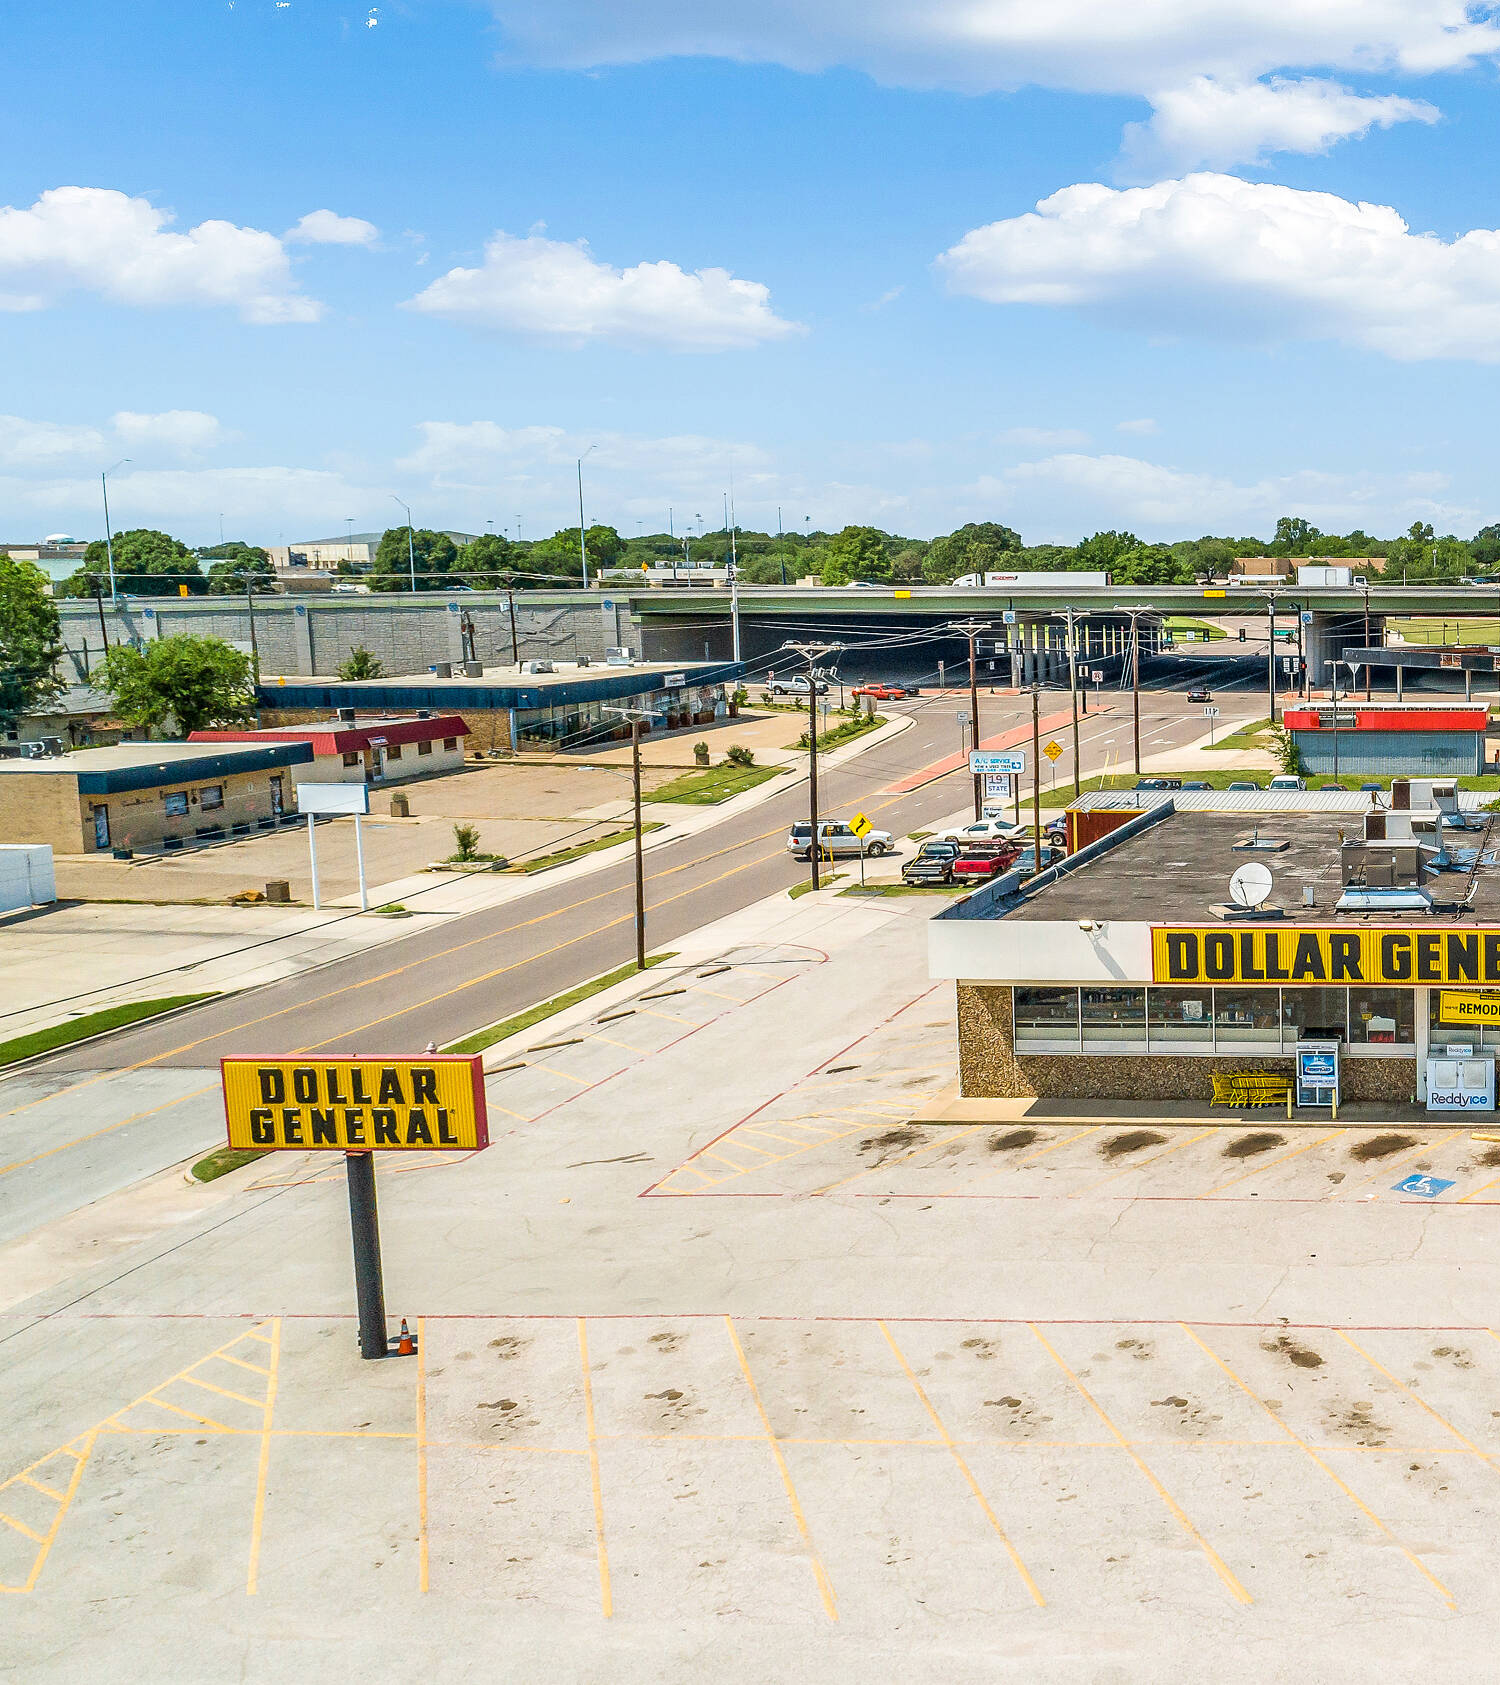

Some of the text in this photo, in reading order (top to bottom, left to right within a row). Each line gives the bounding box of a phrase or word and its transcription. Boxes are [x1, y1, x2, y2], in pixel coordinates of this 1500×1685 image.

[1166, 932, 1364, 981] DOLLAR
[258, 1067, 440, 1105] DOLLAR
[1431, 1092, 1488, 1107] Reddyice
[250, 1107, 458, 1144] GENERAL
